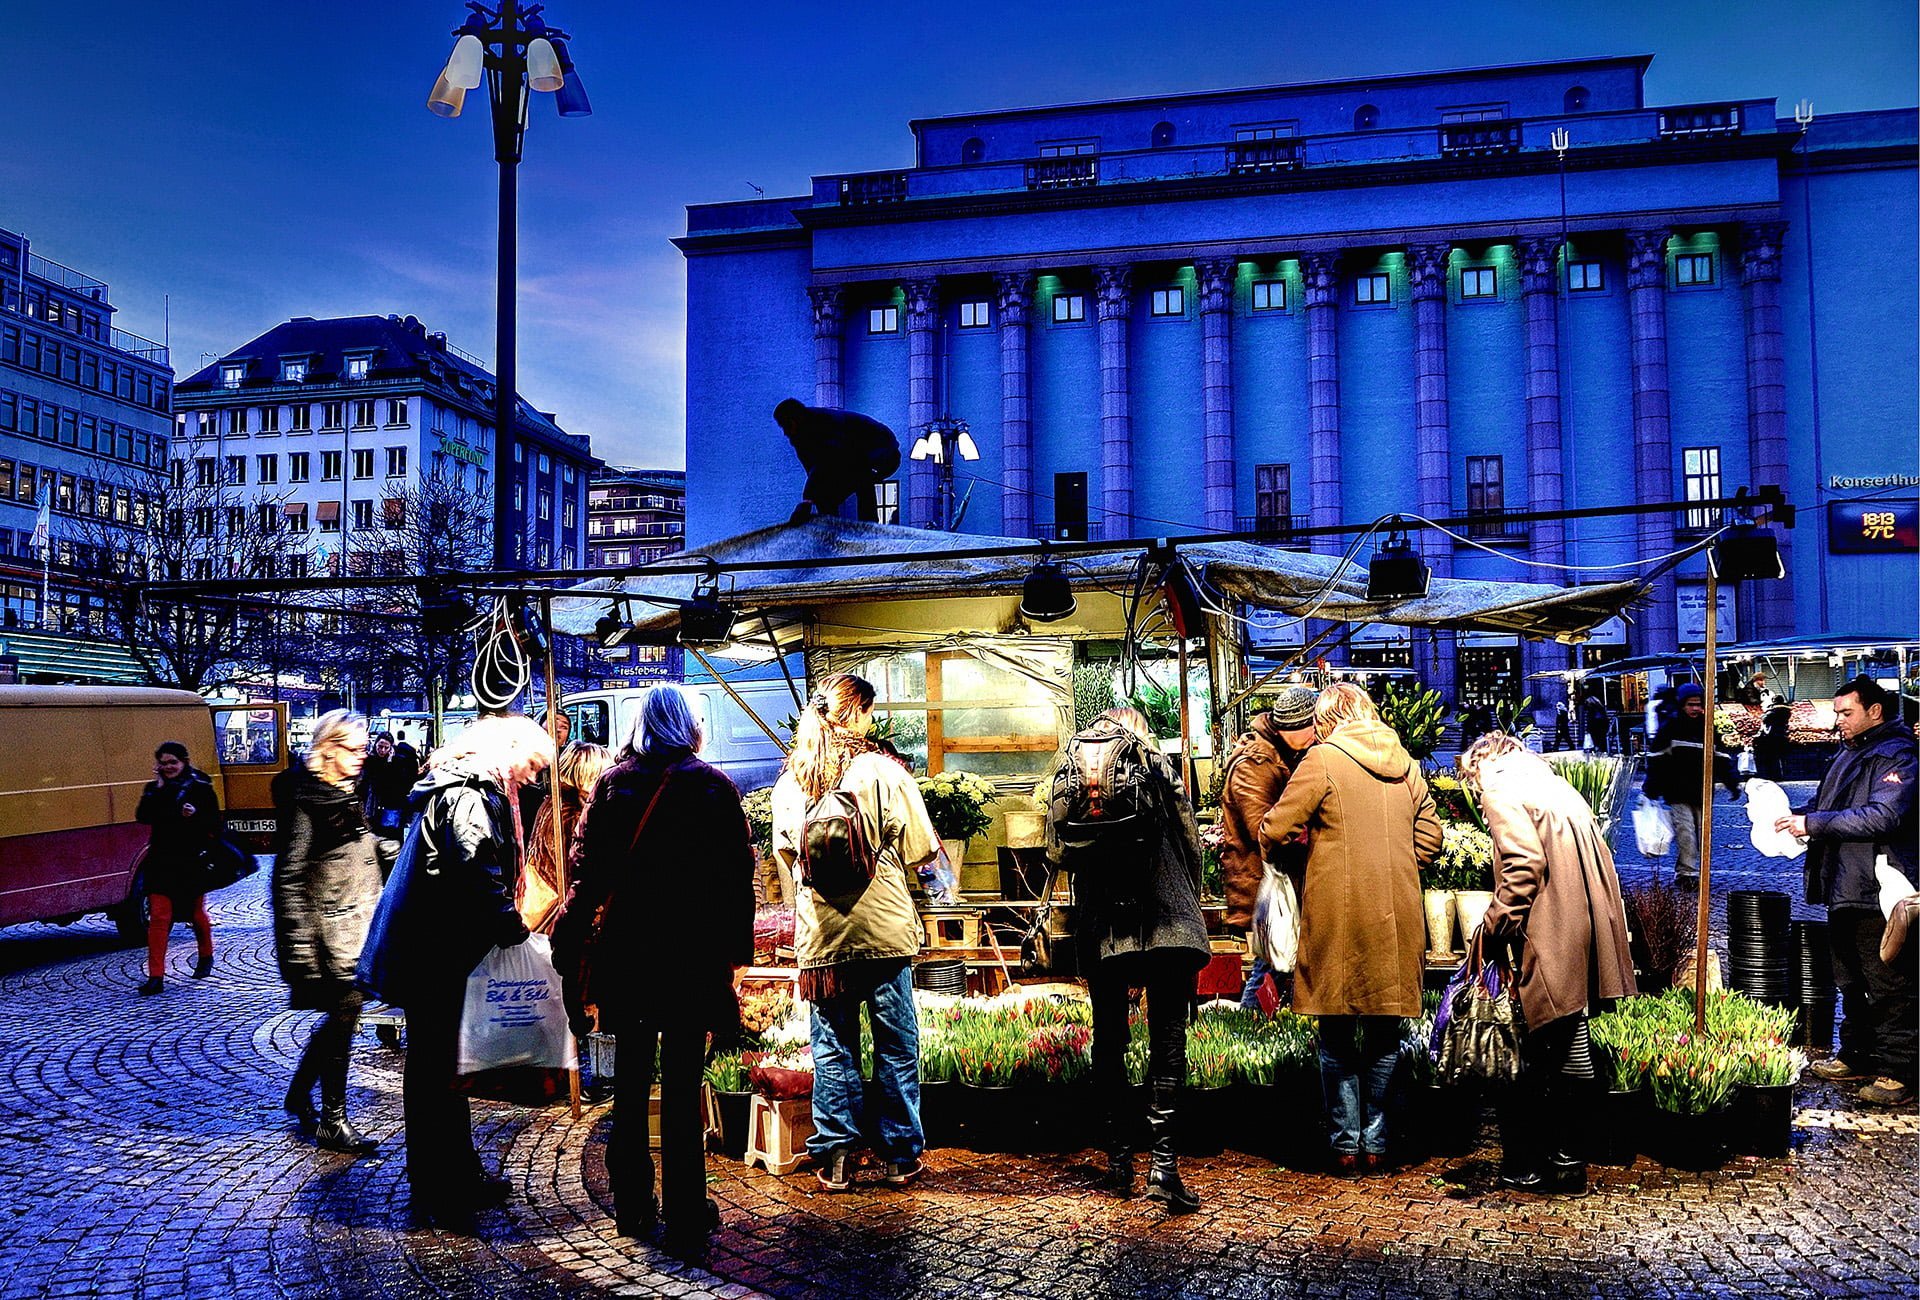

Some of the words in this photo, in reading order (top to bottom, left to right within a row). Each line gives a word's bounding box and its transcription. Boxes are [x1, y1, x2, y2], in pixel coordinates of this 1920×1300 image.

[440, 437, 484, 466] SUPERFUND
[1862, 512, 1895, 526] 18:13
[620, 665, 668, 675] resfeber.se
